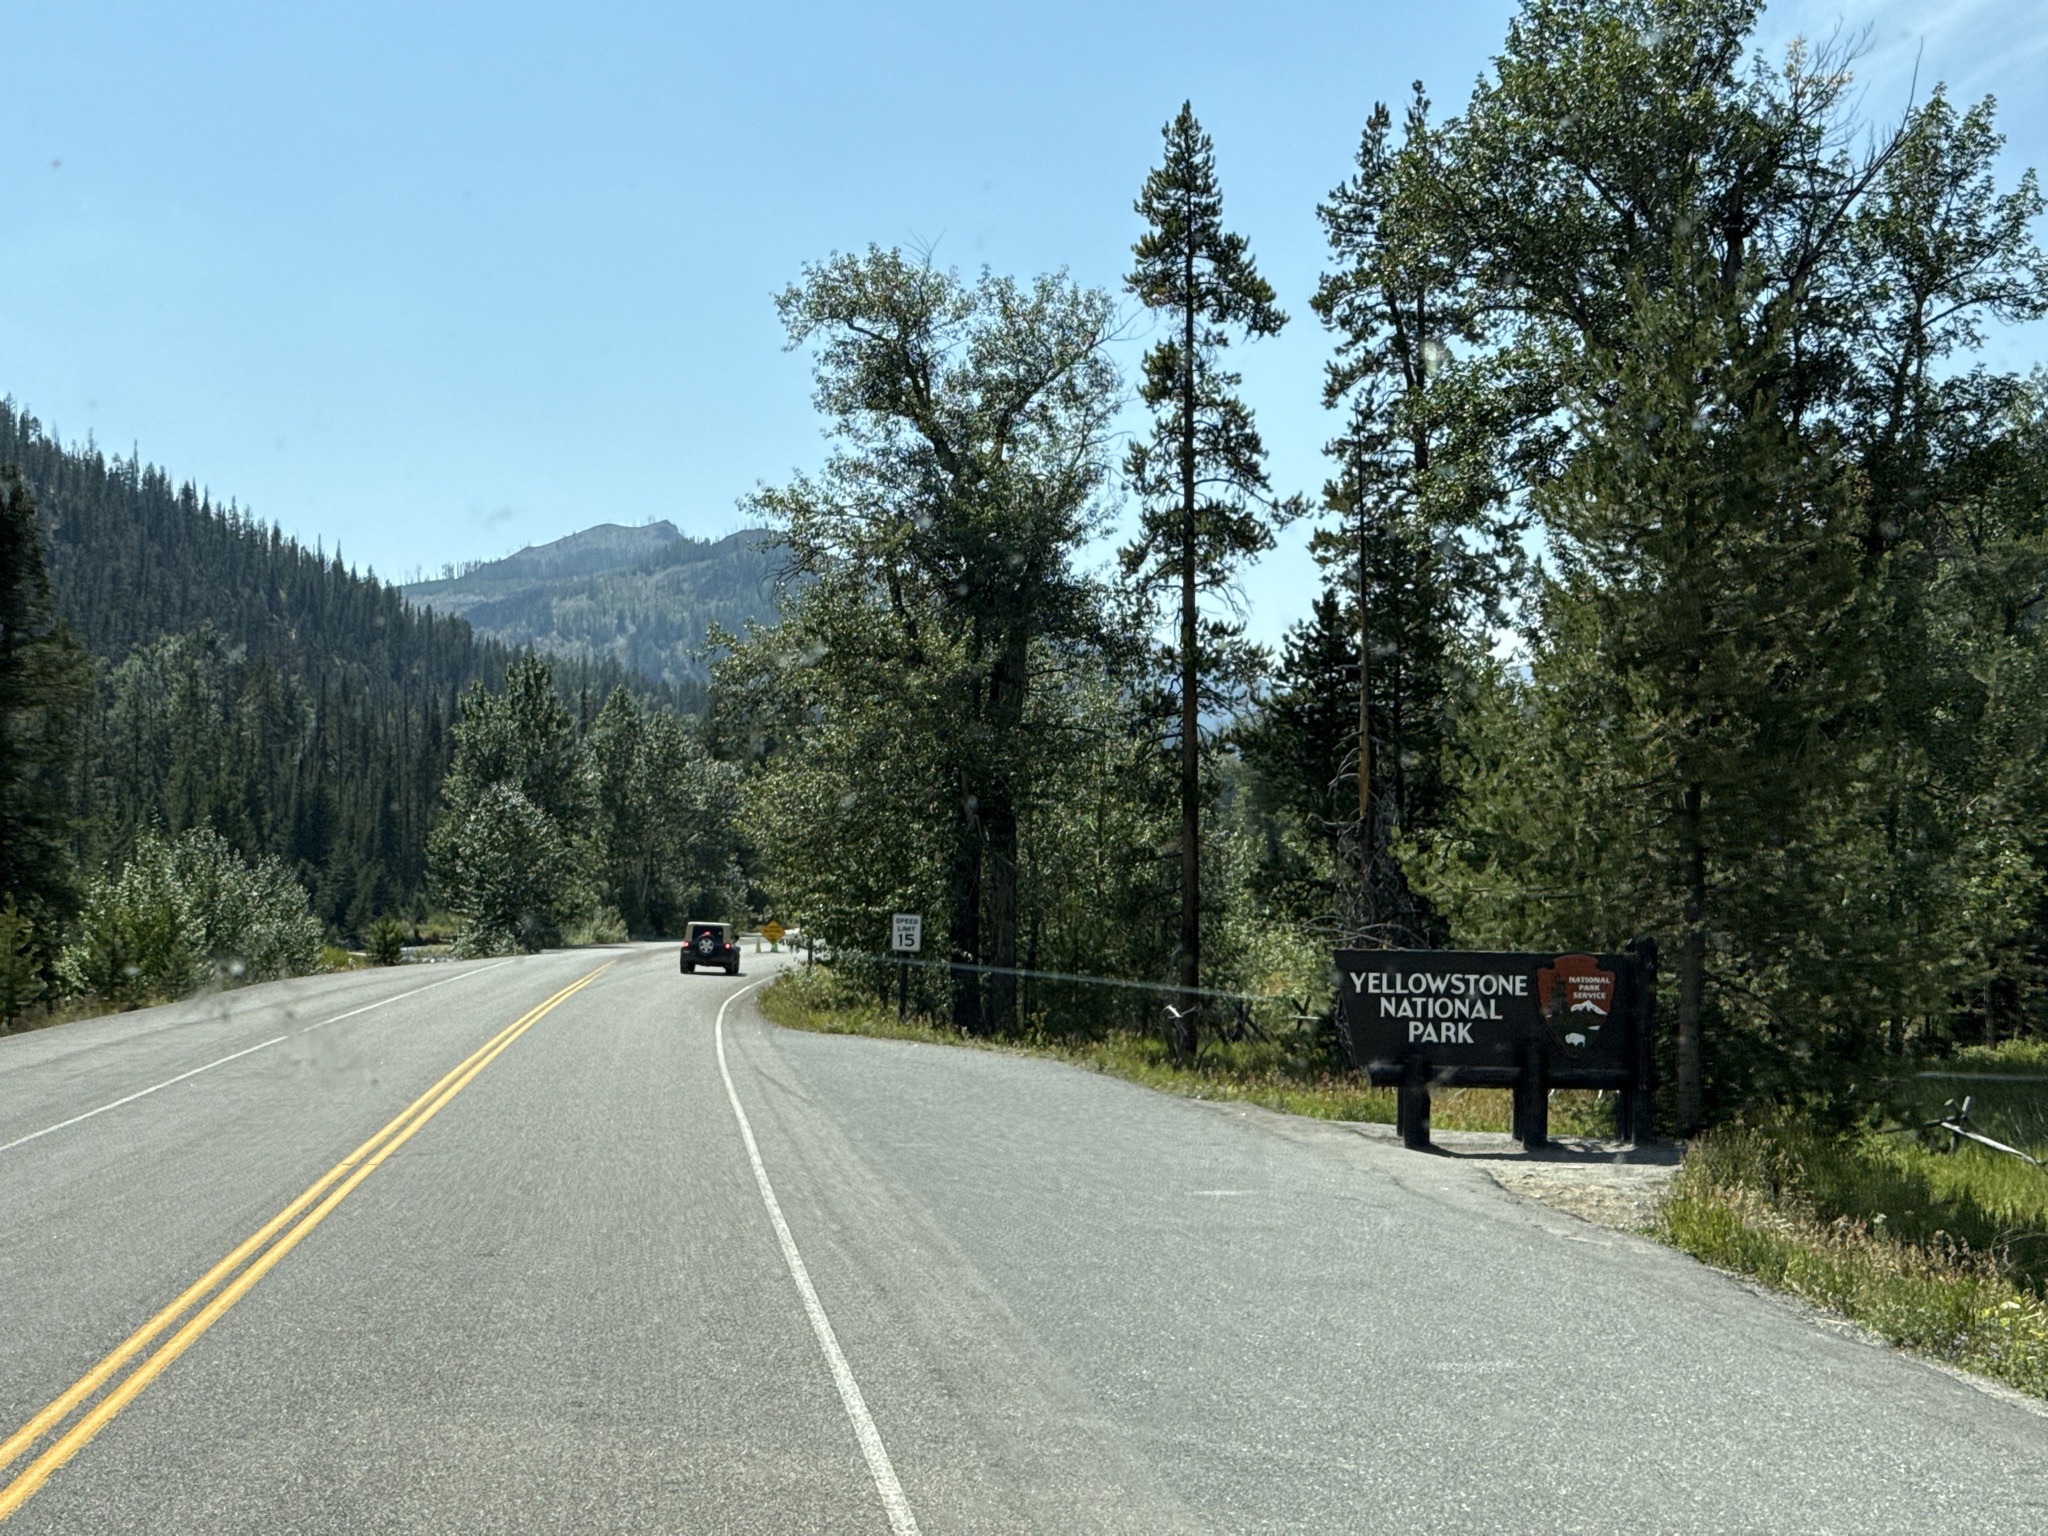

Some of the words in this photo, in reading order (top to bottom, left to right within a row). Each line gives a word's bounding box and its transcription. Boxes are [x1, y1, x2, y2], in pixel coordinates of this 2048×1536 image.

[898, 933, 915, 947] 15
[1350, 972, 1528, 996] YELLOWSTONE
[1568, 976, 1610, 984] NATIONAL
[1380, 997, 1503, 1020] NATIONAL
[1408, 1022, 1474, 1044] PARK
